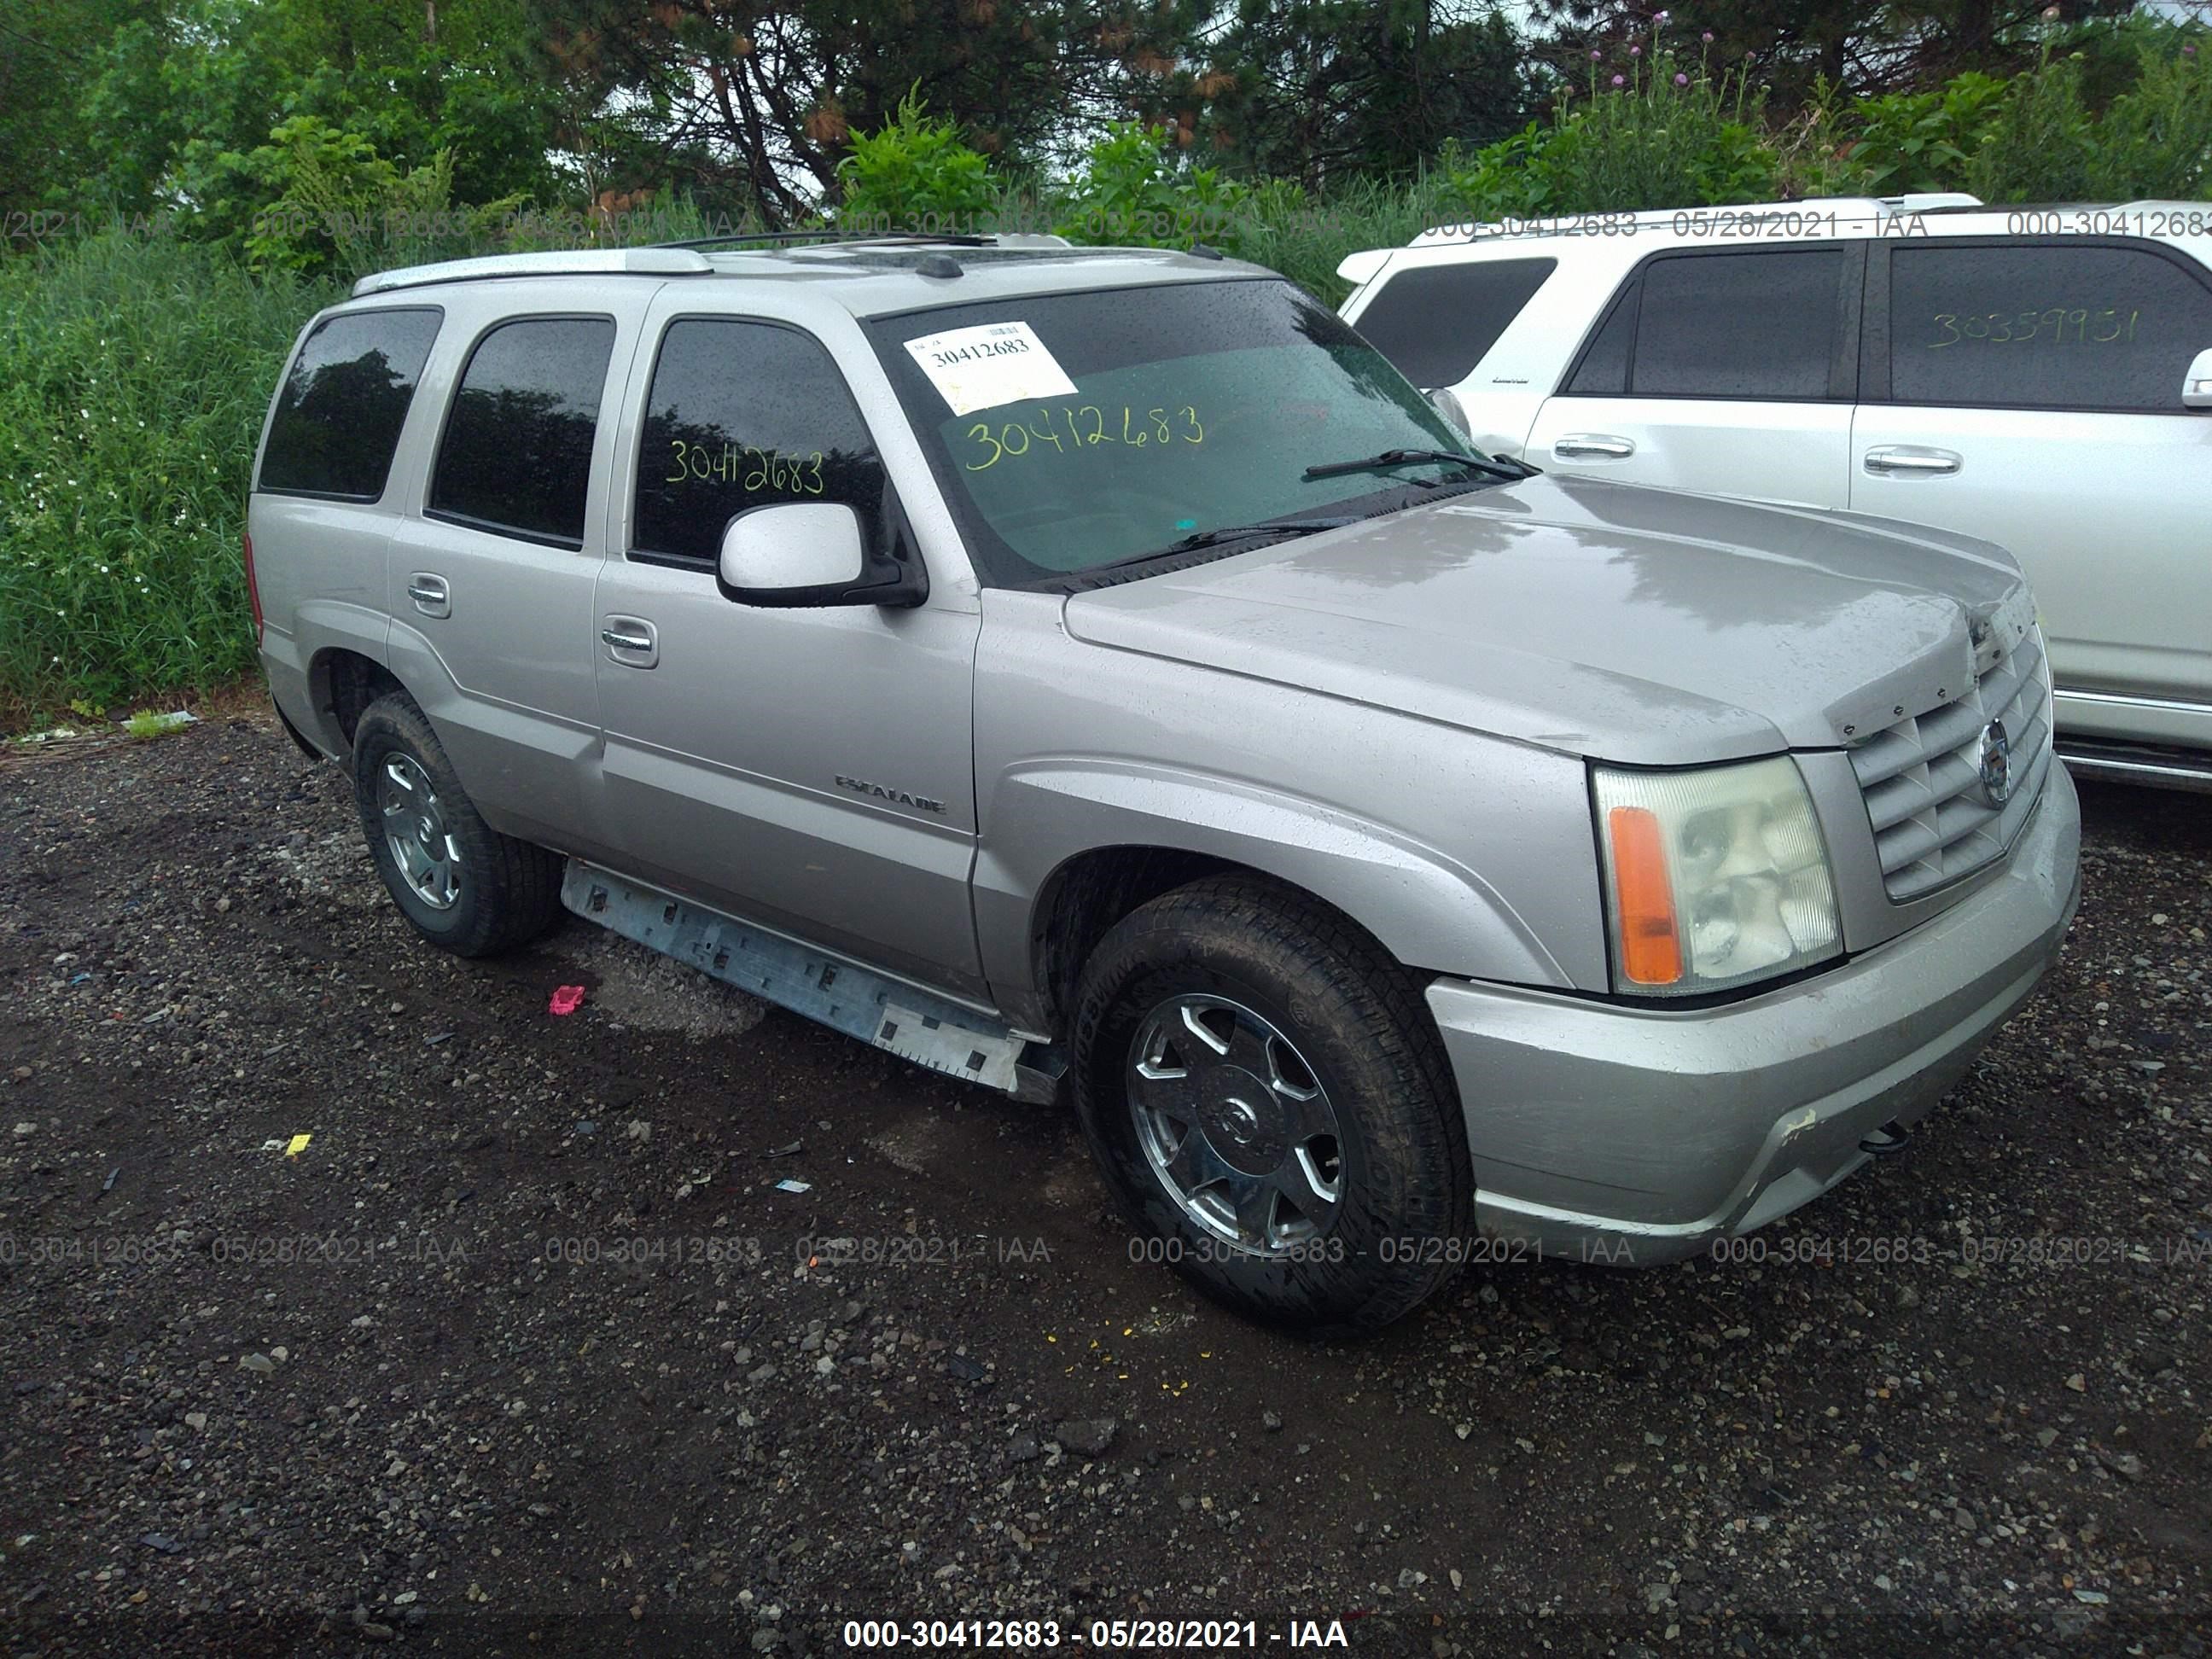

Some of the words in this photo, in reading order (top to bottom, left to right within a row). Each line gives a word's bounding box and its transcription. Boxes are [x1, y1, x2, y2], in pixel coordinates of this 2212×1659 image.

[1928, 308, 2138, 348] 30359951
[931, 339, 1030, 368] 30412683
[966, 406, 1204, 470] 30412683
[666, 440, 824, 494] 30412683
